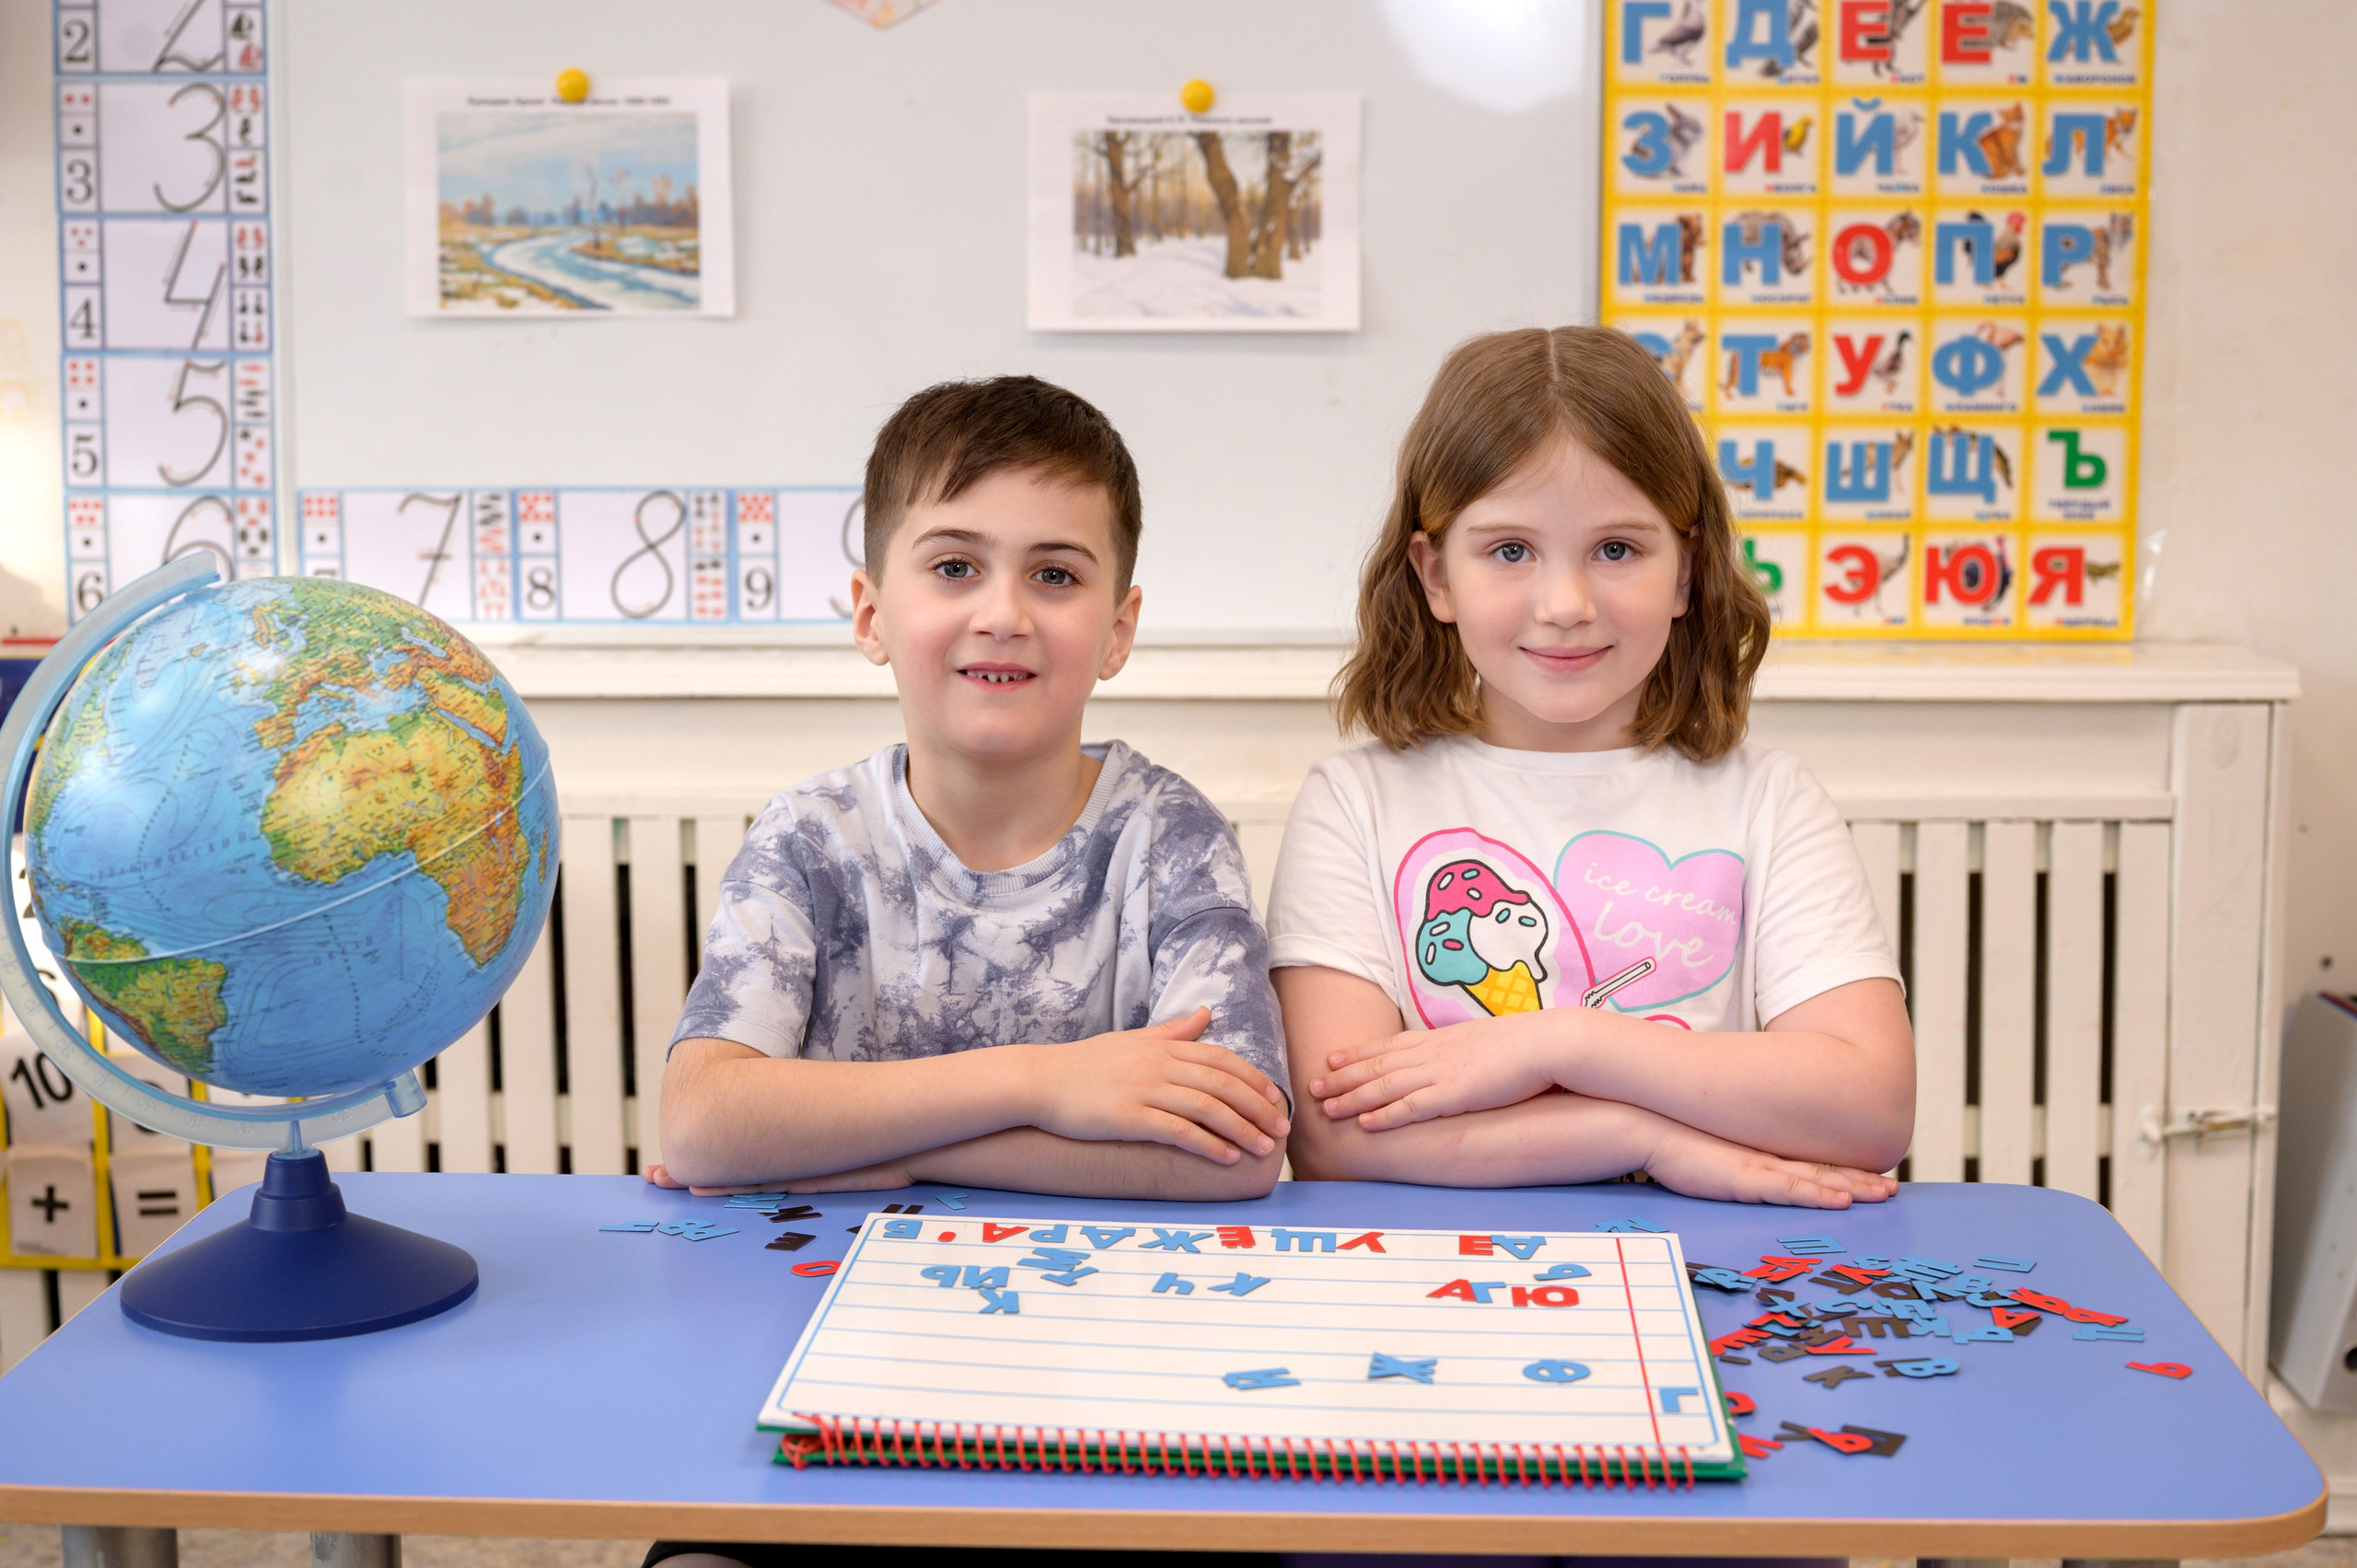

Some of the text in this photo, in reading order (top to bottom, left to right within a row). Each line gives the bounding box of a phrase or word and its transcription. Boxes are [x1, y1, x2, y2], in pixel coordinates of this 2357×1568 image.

[63, 18, 89, 63] 2
[1623, 2, 1671, 63] Г
[1725, 0, 1794, 67] Д
[1840, 1, 1891, 61] Е
[2047, 0, 2119, 62] Ж
[154, 83, 226, 212] 3
[1621, 110, 1672, 175] З
[1724, 110, 1781, 172] И
[1836, 98, 1894, 175] Й
[1938, 112, 1992, 175] К
[2042, 114, 2105, 176] Л
[66, 158, 93, 203] 3
[165, 220, 226, 350] 4
[1619, 224, 1681, 285] М
[1723, 224, 1781, 285] Н
[1832, 224, 1893, 285] О
[1935, 224, 1993, 285] П
[2042, 225, 2095, 287] Р
[70, 297, 96, 338] 4
[1721, 335, 1777, 396] Т
[1833, 335, 1883, 396] У
[1933, 336, 2002, 396] Ф
[2036, 335, 2098, 396] Х
[157, 358, 228, 487] 5
[72, 434, 98, 477] 5
[1720, 441, 1773, 499] Ч
[1826, 442, 1891, 501] Ш
[1928, 435, 1995, 503] Щ
[2048, 431, 2107, 488] Ъ
[399, 493, 463, 607] 7
[611, 491, 686, 619] 8
[1743, 540, 1782, 595] Ь
[1824, 544, 1880, 604] Э
[1925, 546, 2000, 605] Ю
[2027, 546, 2084, 605] Я
[77, 571, 103, 613] 6
[527, 566, 555, 610] 8
[745, 567, 773, 610] 9
[1585, 863, 1738, 926] ice cream
[1595, 900, 1714, 968] love
[10, 1051, 73, 1109] 10
[1138, 1228, 1213, 1253] Ж
[979, 1290, 1019, 1314] К
[1523, 1359, 1590, 1385] Ф
